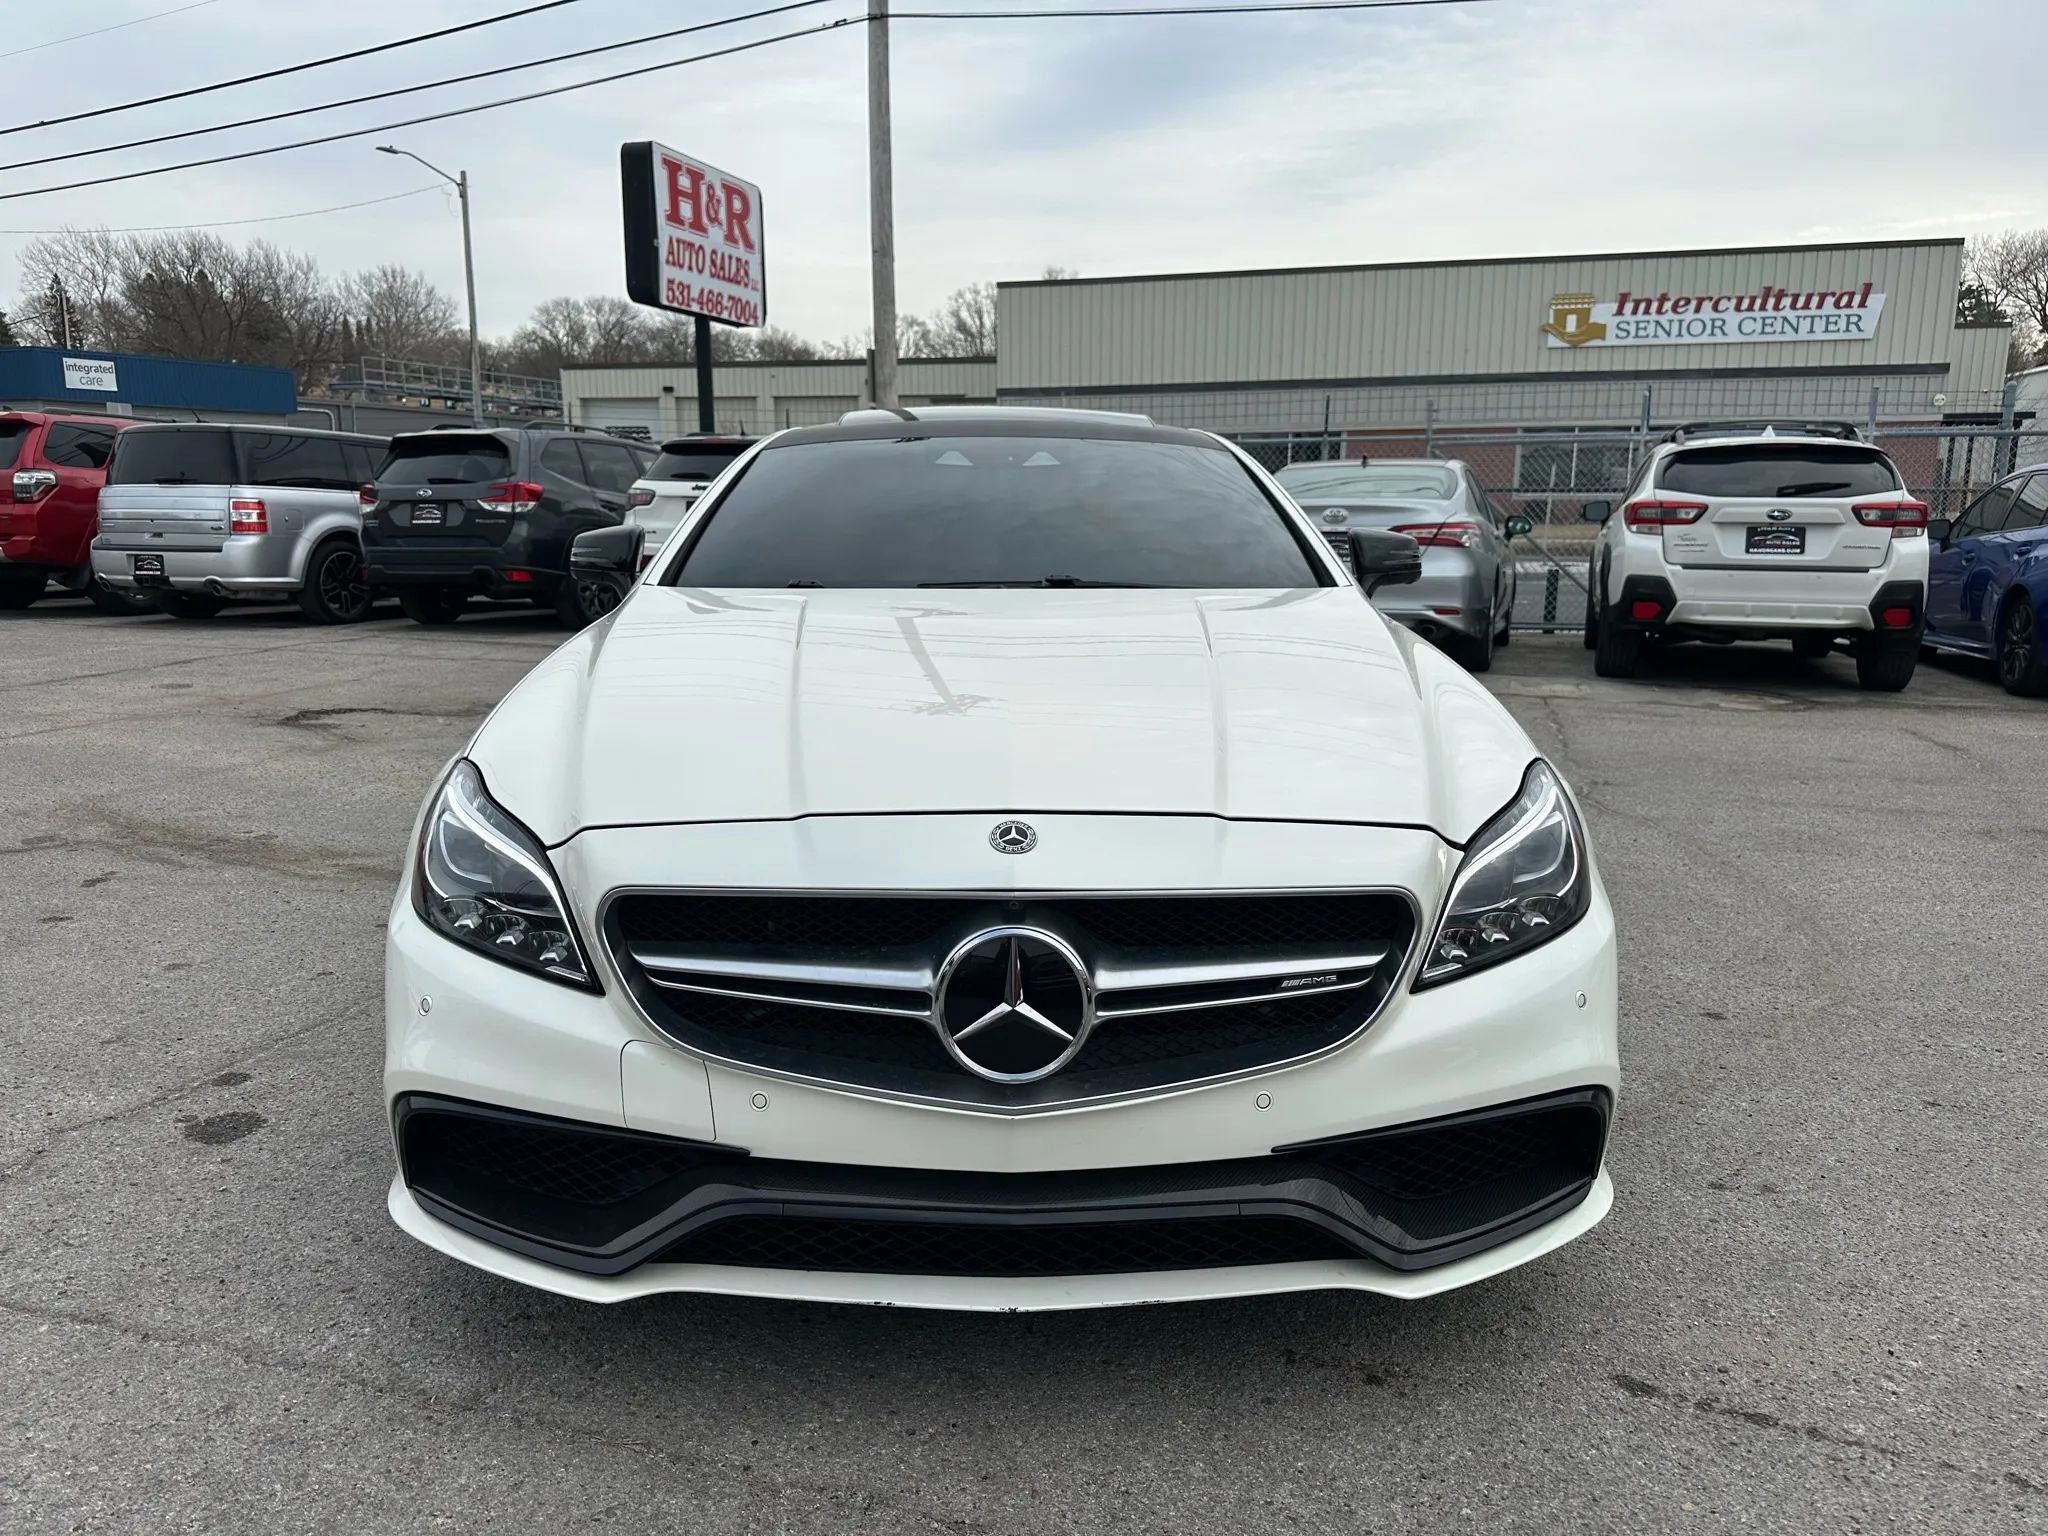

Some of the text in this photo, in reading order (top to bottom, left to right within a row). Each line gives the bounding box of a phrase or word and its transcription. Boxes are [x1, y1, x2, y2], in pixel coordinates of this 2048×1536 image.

[660, 153, 756, 254] H&R
[666, 236, 750, 288] AUTO SALES
[666, 278, 758, 324] 531-466-7004
[1612, 282, 1873, 317] Intercultural
[1615, 313, 1865, 340] SENIOR CENTER
[65, 360, 114, 375] integrated
[79, 376, 104, 386] care
[1299, 975, 1337, 986] AMG
